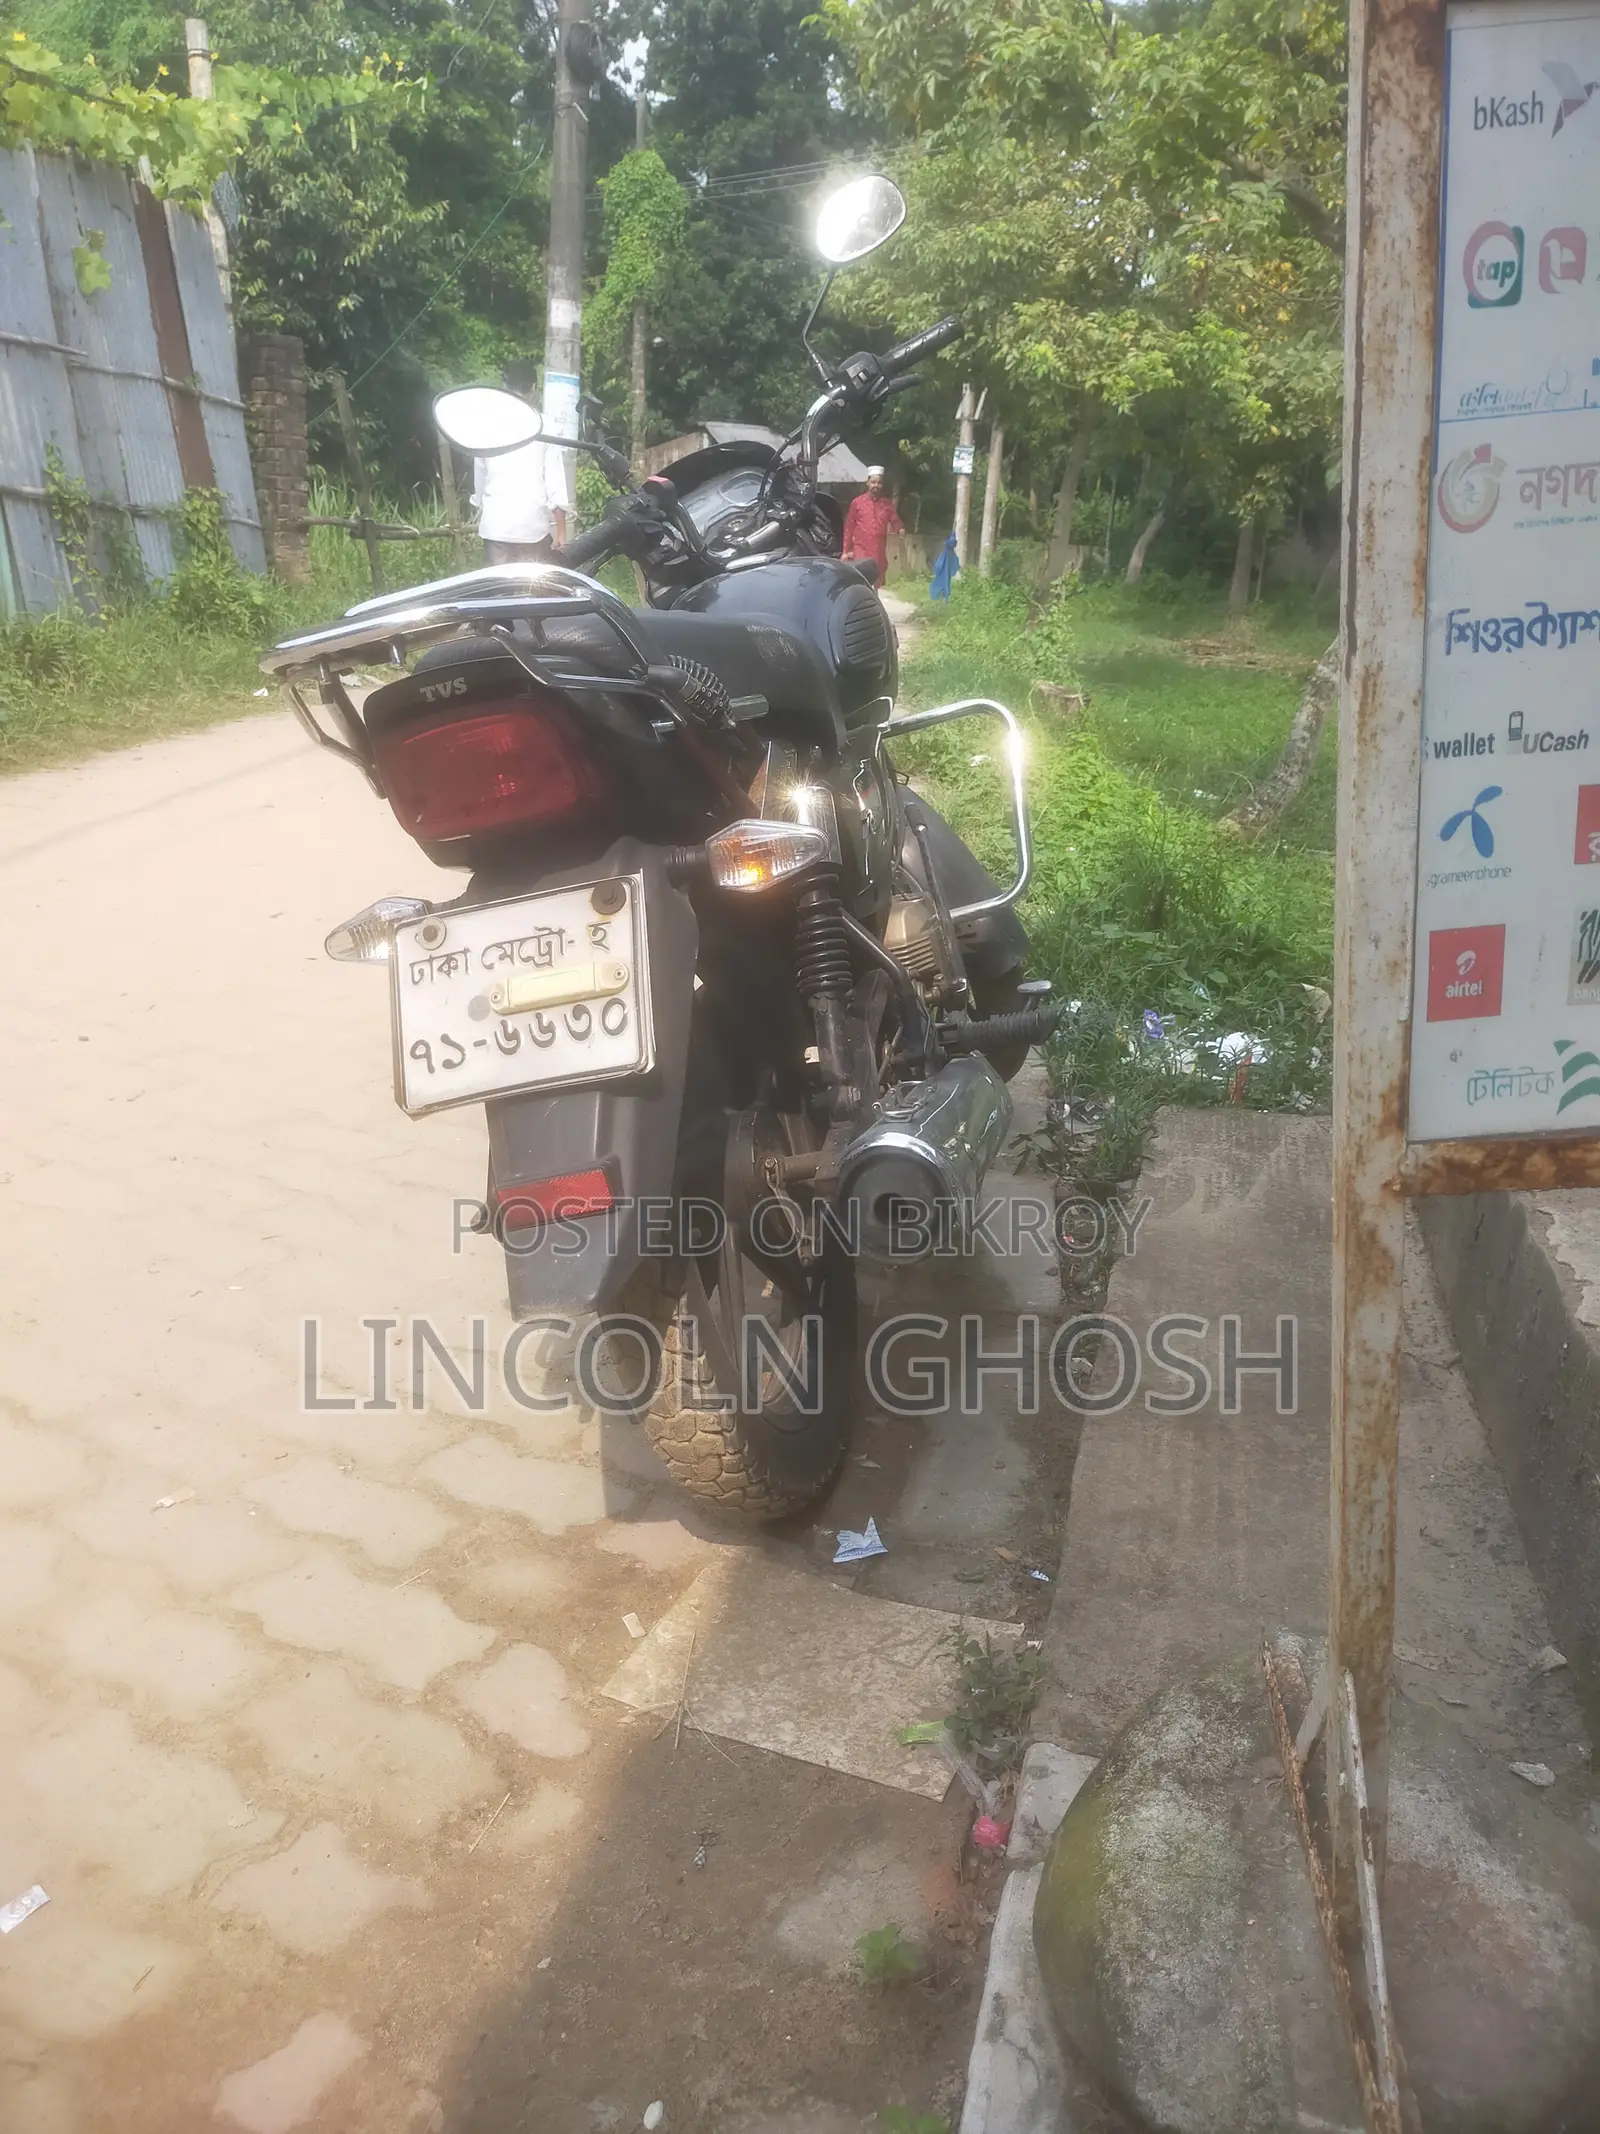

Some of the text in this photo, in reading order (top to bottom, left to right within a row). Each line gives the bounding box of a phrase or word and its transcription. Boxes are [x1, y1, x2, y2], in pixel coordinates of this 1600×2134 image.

[1473, 90, 1544, 131] bKash
[1476, 259, 1516, 288] tap
[1515, 461, 1600, 512] নগদ
[420, 676, 468, 702] TVS
[1433, 732, 1495, 759] wallet
[1523, 729, 1589, 754] UCash
[1430, 866, 1512, 889] grameenphone
[408, 947, 471, 986] ঢাকা
[1445, 979, 1483, 998] airtel
[409, 997, 629, 1074] ৭১-৬৬৩০
[1467, 1066, 1555, 1106] টেলিটক
